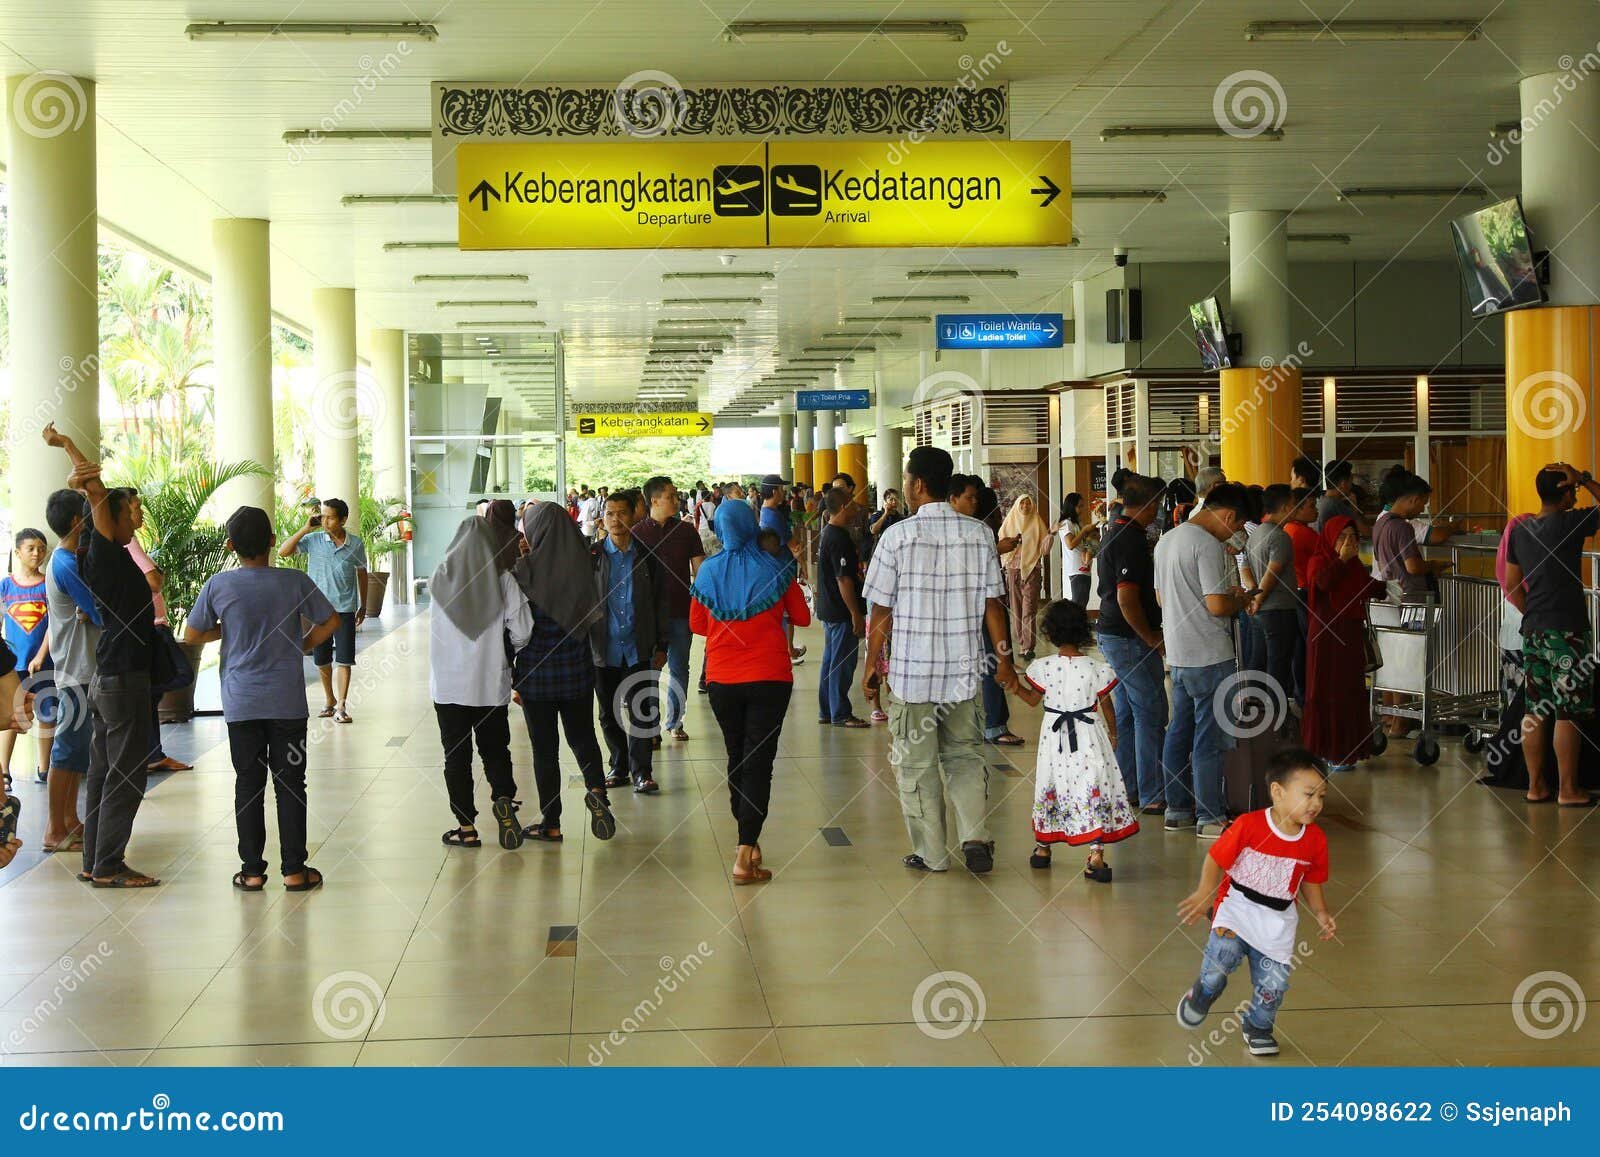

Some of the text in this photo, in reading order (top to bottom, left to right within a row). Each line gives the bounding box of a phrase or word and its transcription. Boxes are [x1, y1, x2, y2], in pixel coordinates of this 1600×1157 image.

[505, 171, 711, 212] Keberangkatan
[824, 169, 1001, 209] Kedatangan
[637, 211, 712, 228] Departure
[824, 210, 871, 223] Arrival
[979, 321, 1042, 331] Toilet Wanita
[978, 333, 1027, 341] Ladies Toilet
[838, 393, 851, 401] Pria
[601, 416, 689, 429] Keberangkatan
